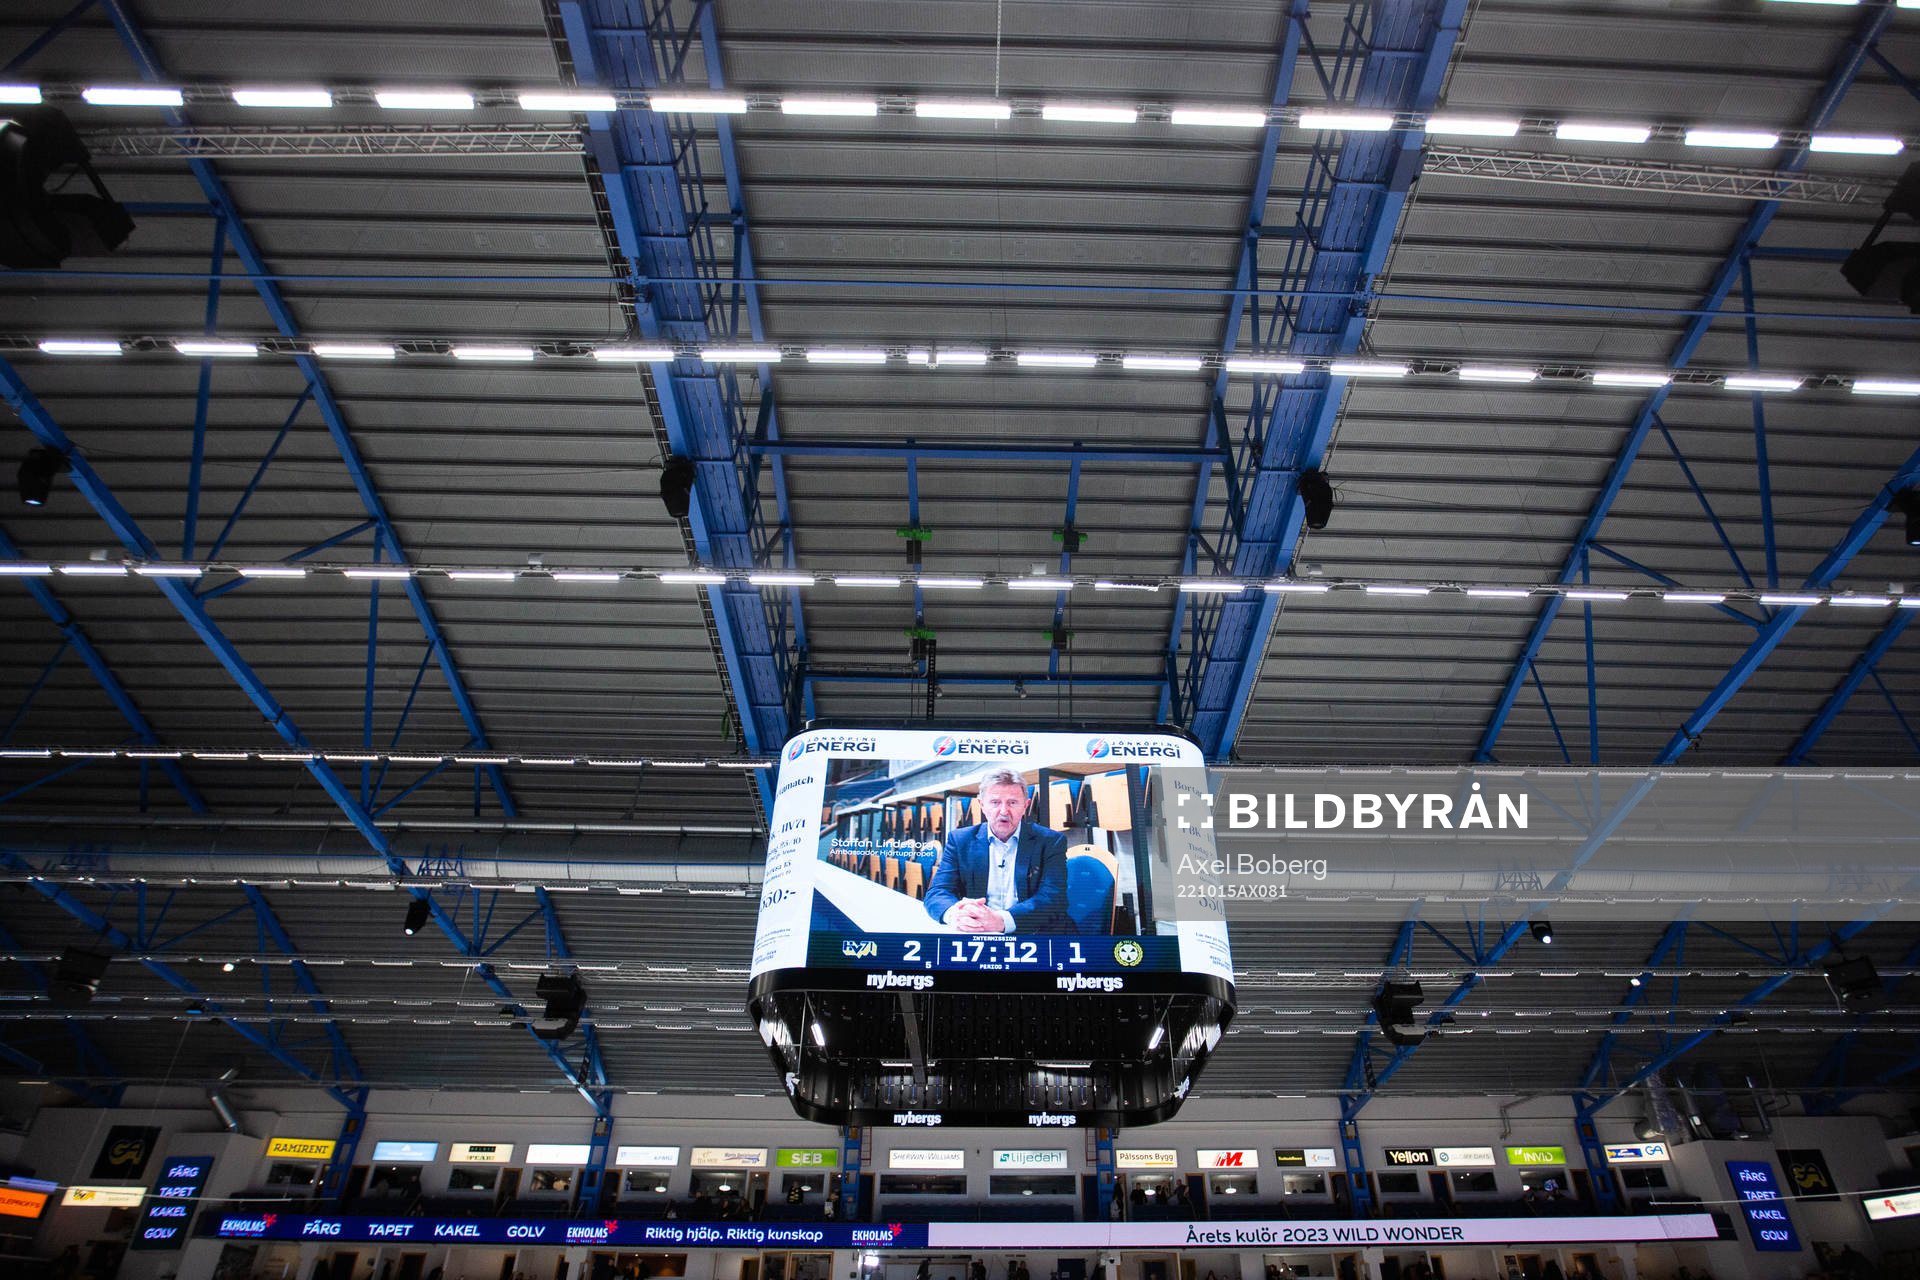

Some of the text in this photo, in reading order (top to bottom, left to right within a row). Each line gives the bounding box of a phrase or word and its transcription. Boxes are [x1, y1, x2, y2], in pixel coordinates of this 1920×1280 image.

[805, 742, 876, 753] ENERGI
[958, 744, 1029, 755] ENERGI
[1112, 746, 1181, 758] ENERGI
[831, 838, 873, 848] Staffan
[876, 839, 935, 851] Lindeborg
[830, 848, 878, 856] Ambassador
[903, 941, 921, 961] 2
[951, 942, 1037, 963] 17:12
[1069, 943, 1086, 963] 1
[925, 961, 932, 969] 5
[867, 971, 934, 989] nybergs
[1057, 973, 1123, 991] nybergs
[893, 1111, 941, 1126] nybergs
[1028, 1112, 1076, 1126] nybergs
[273, 1143, 329, 1155] RAMIRENT
[791, 1152, 822, 1164] SEB
[1155, 1152, 1174, 1162] Bygg
[1390, 1150, 1429, 1164] Yellon
[168, 1164, 200, 1178] FÄRG
[1739, 1169, 1768, 1182] FÄRG
[159, 1186, 196, 1197] TAPET
[1743, 1190, 1777, 1201] TAPET
[150, 1206, 187, 1217] KAKEL
[1750, 1209, 1786, 1220] KAKEL
[144, 1227, 177, 1239] GOLV
[220, 1219, 546, 1238] EKHOLMS FÄRG TAPET KAKEL GOLV
[566, 1227, 608, 1239] EKHOLMS
[1186, 1224, 1464, 1243] Årets kulör 2023 WILD WONDER
[645, 1227, 823, 1244] Riktig hjälp. Riktig kunskap
[852, 1230, 893, 1241] EKHOLMS
[1760, 1230, 1789, 1241] GOLV
